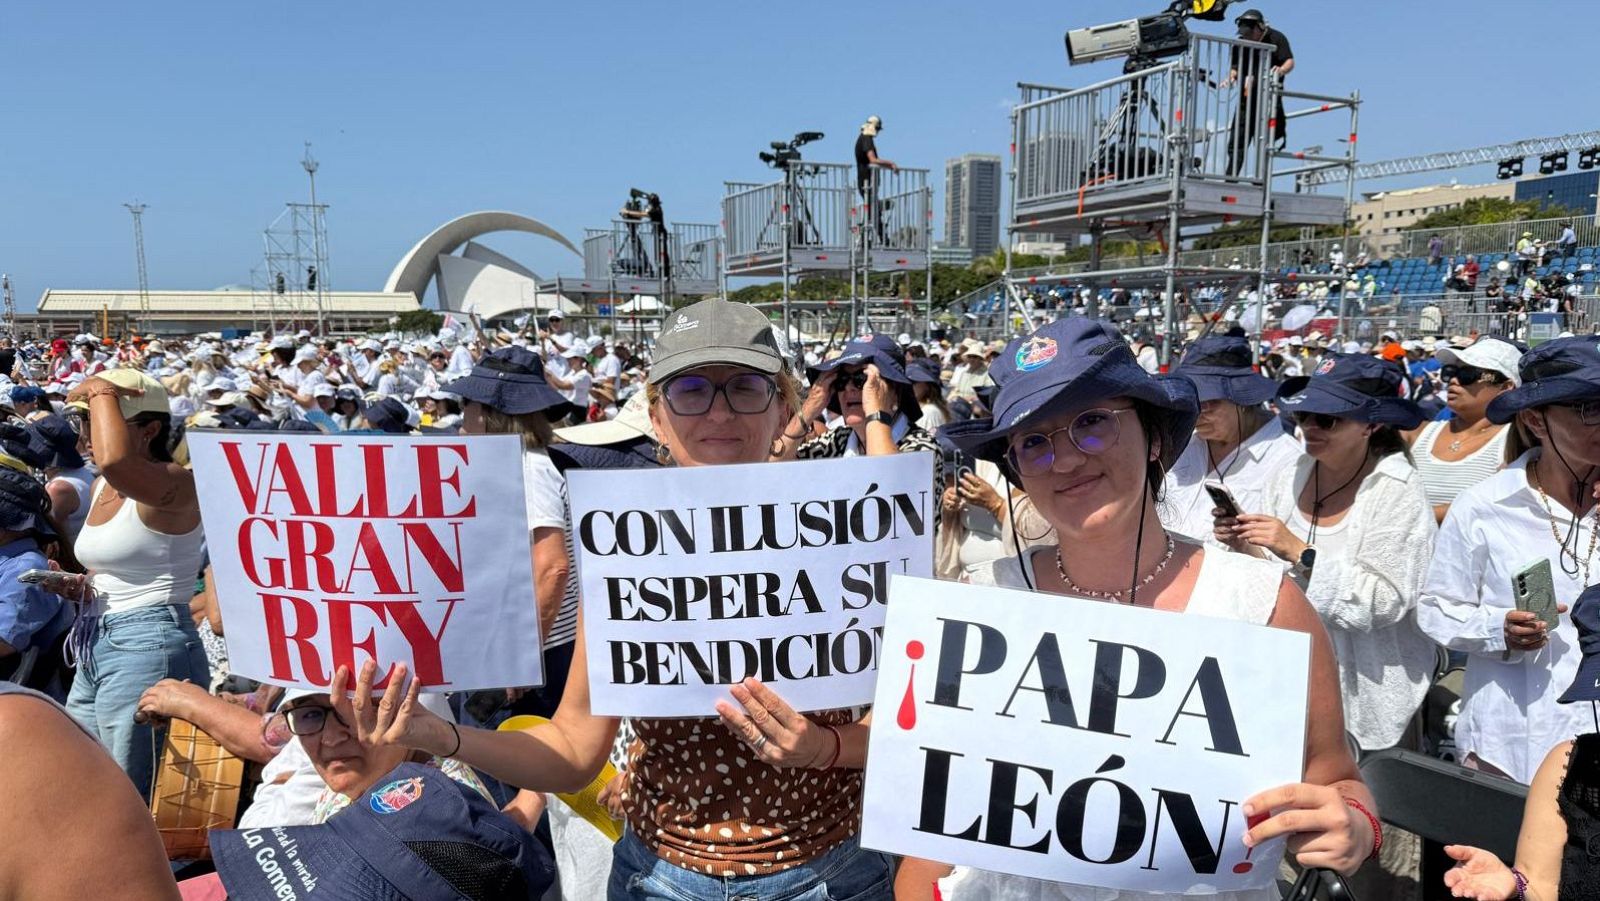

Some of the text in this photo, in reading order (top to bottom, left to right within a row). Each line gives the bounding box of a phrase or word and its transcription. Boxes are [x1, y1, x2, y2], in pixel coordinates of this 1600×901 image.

[219, 441, 477, 518] VALLE
[237, 517, 465, 595] GRAN
[579, 482, 928, 557] CON ILUSIÓN
[604, 568, 826, 622] ESPERA
[257, 592, 465, 690] REY
[896, 617, 1251, 758] ¡PAPA
[242, 828, 264, 849] La
[285, 844, 298, 859] la
[292, 859, 319, 893] mirada
